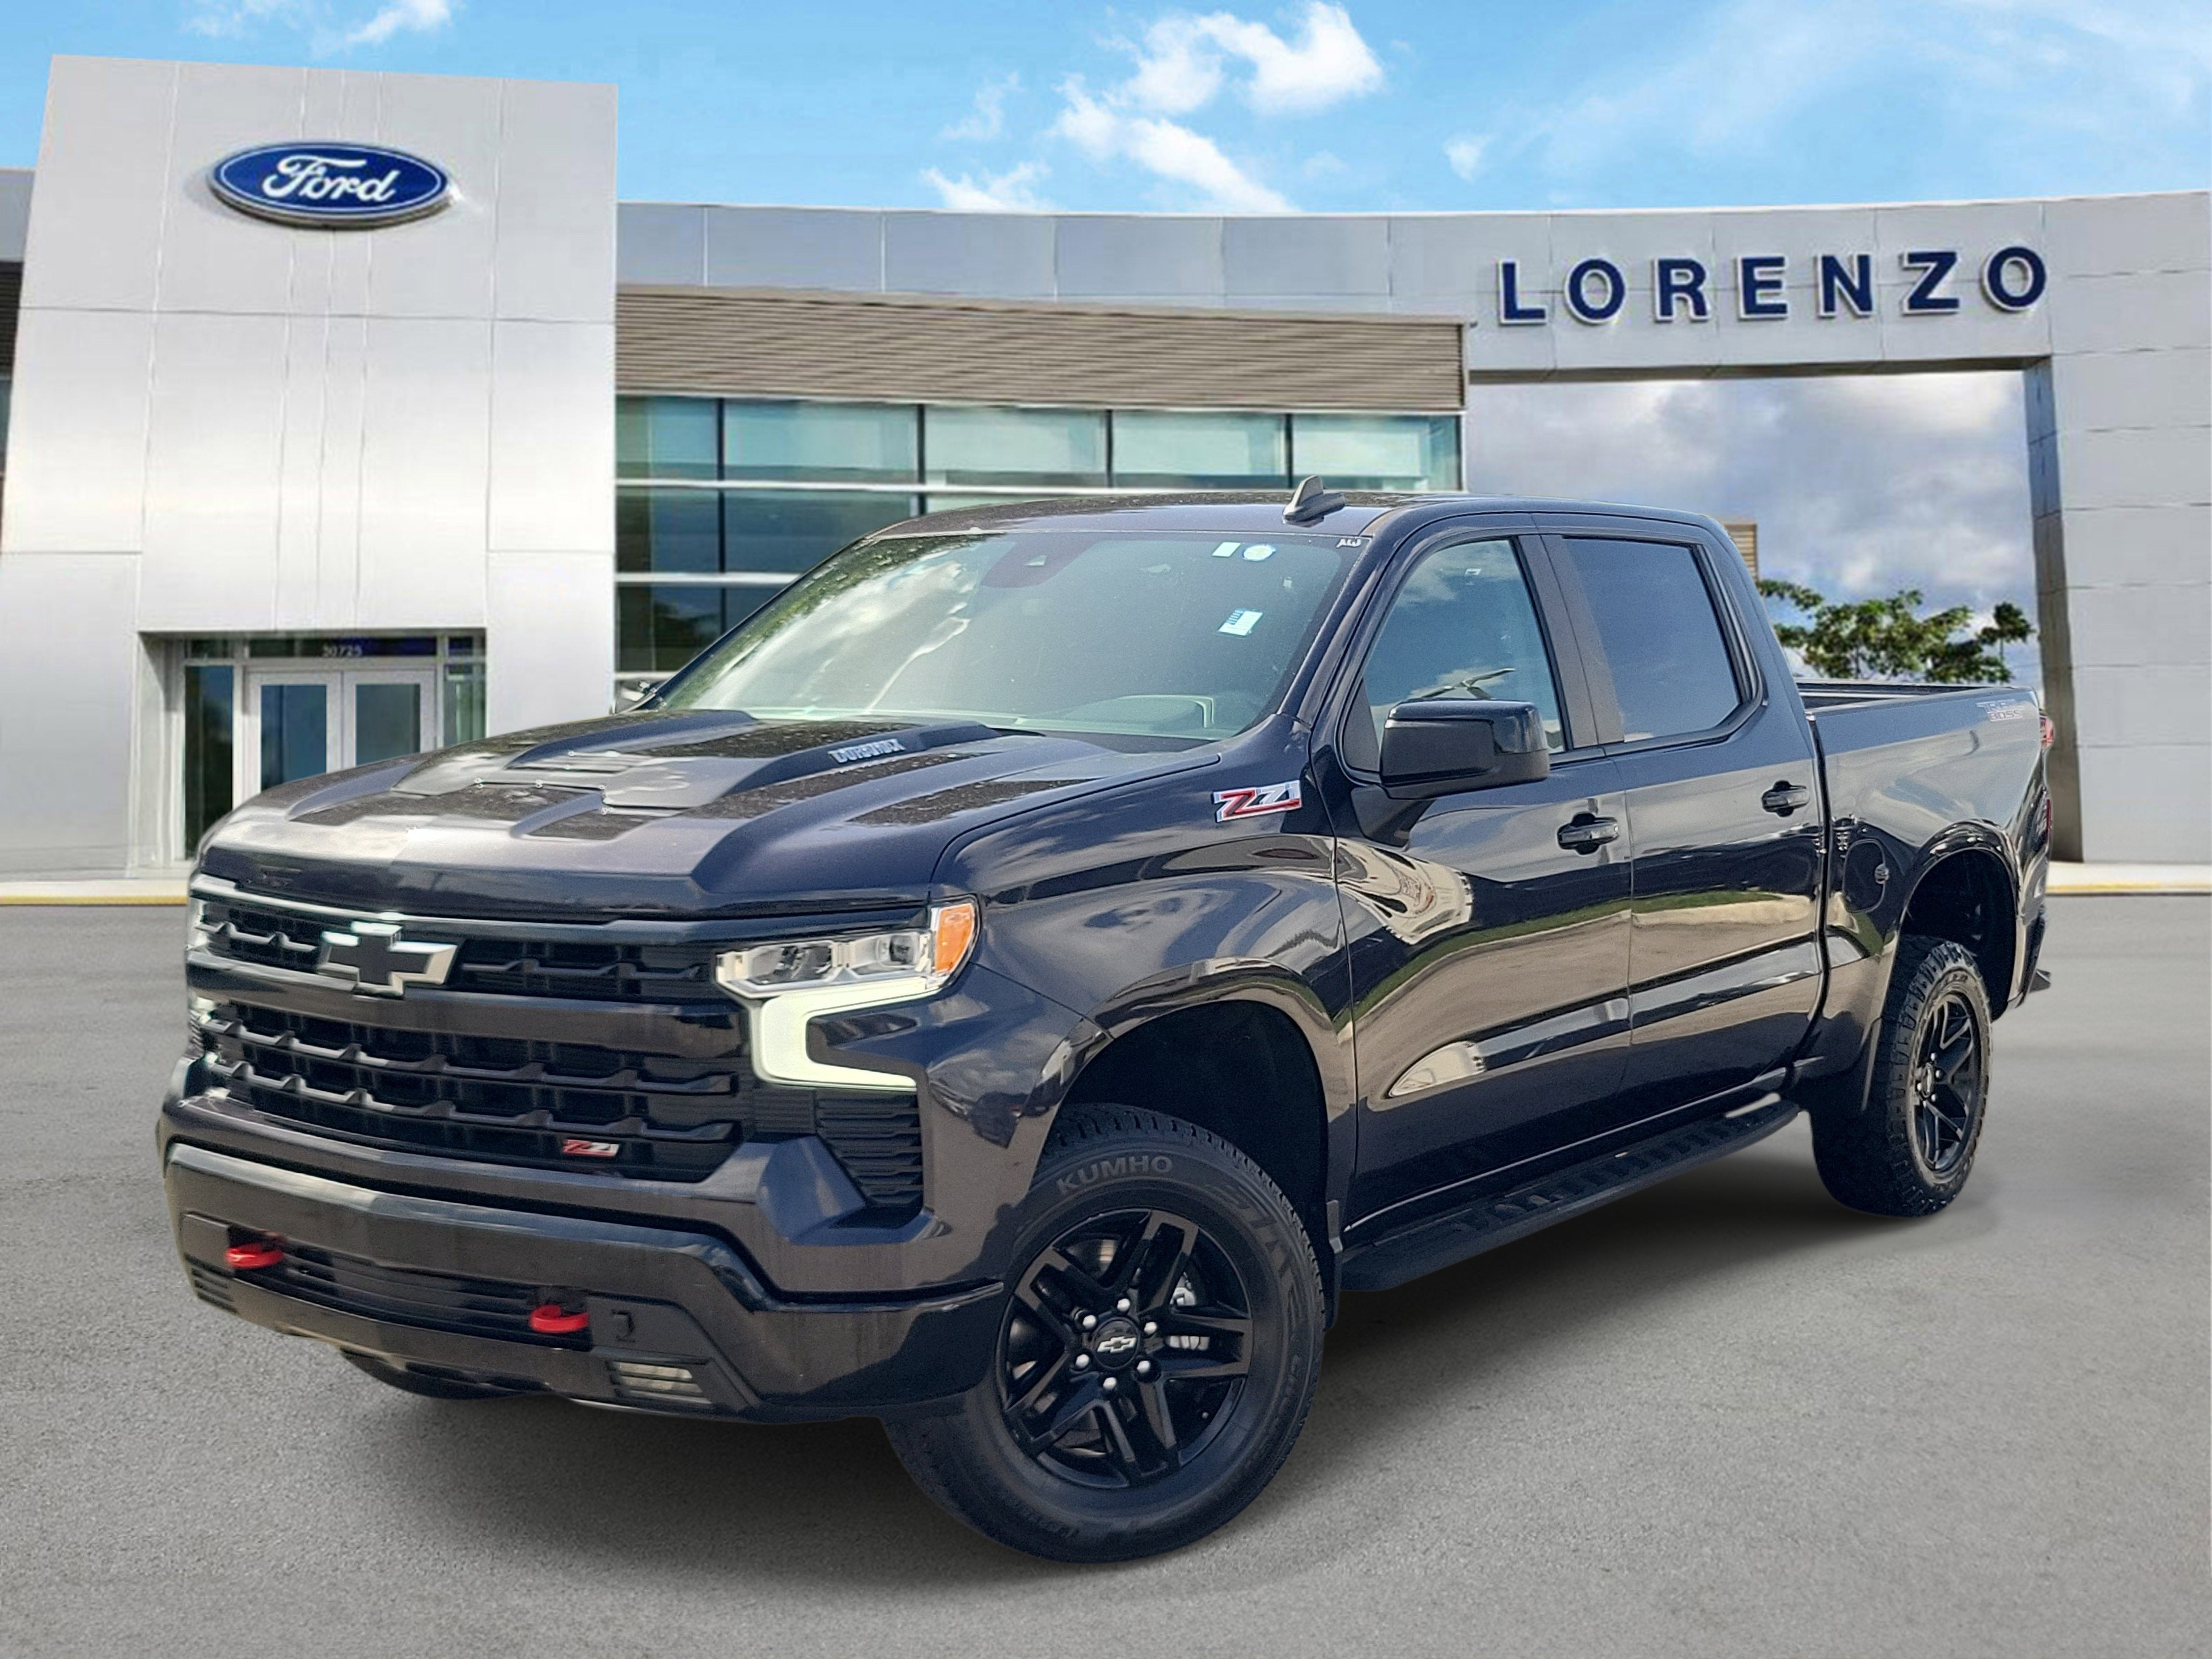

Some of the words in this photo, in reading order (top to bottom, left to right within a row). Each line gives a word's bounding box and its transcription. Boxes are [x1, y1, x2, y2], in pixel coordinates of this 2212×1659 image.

[262, 154, 401, 202] Ford
[1499, 247, 2047, 323] LORENZO
[1987, 710, 2023, 722] BOSS
[1211, 779, 1301, 823] Z71
[562, 1139, 620, 1158] Z71
[1056, 1155, 1173, 1195] KUMHO
